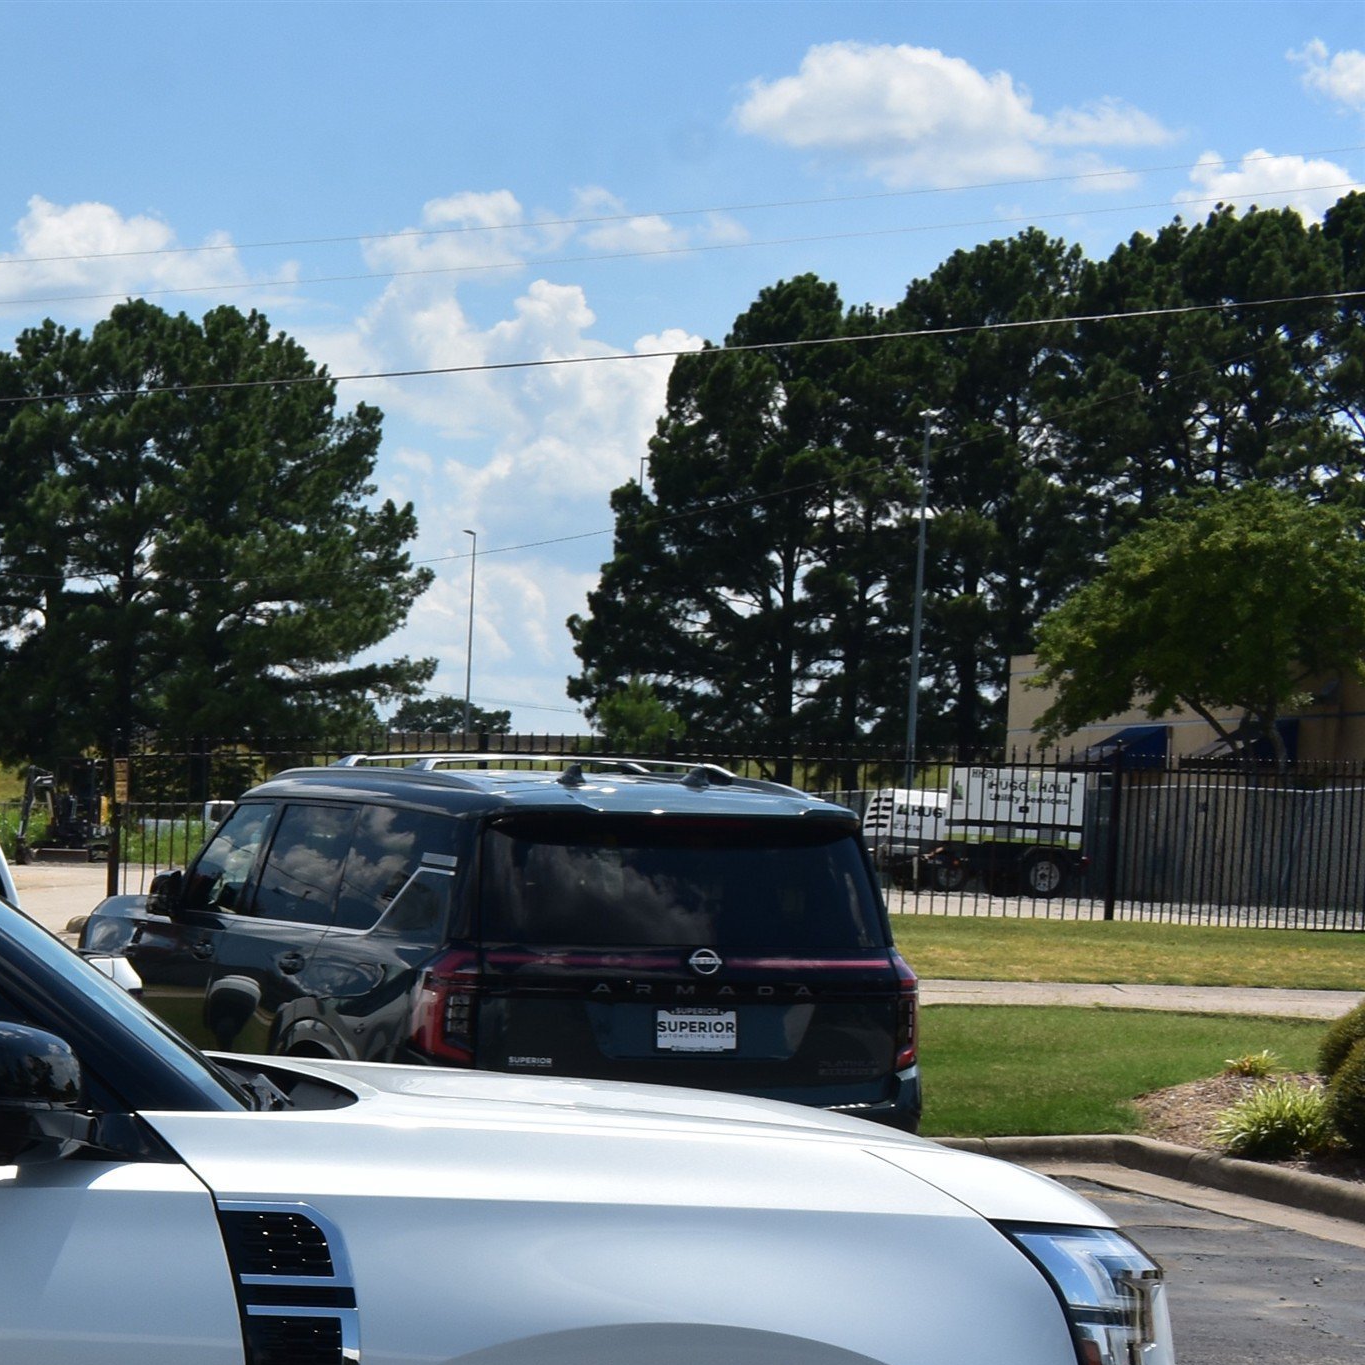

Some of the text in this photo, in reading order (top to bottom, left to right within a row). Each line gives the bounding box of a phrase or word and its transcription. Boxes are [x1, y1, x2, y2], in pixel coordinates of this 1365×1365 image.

[591, 982, 813, 997] ARMADA
[675, 1007, 719, 1015] SUPERIOR
[657, 1020, 736, 1033] SUPERIOR
[508, 1056, 552, 1065] SUPERIOR
